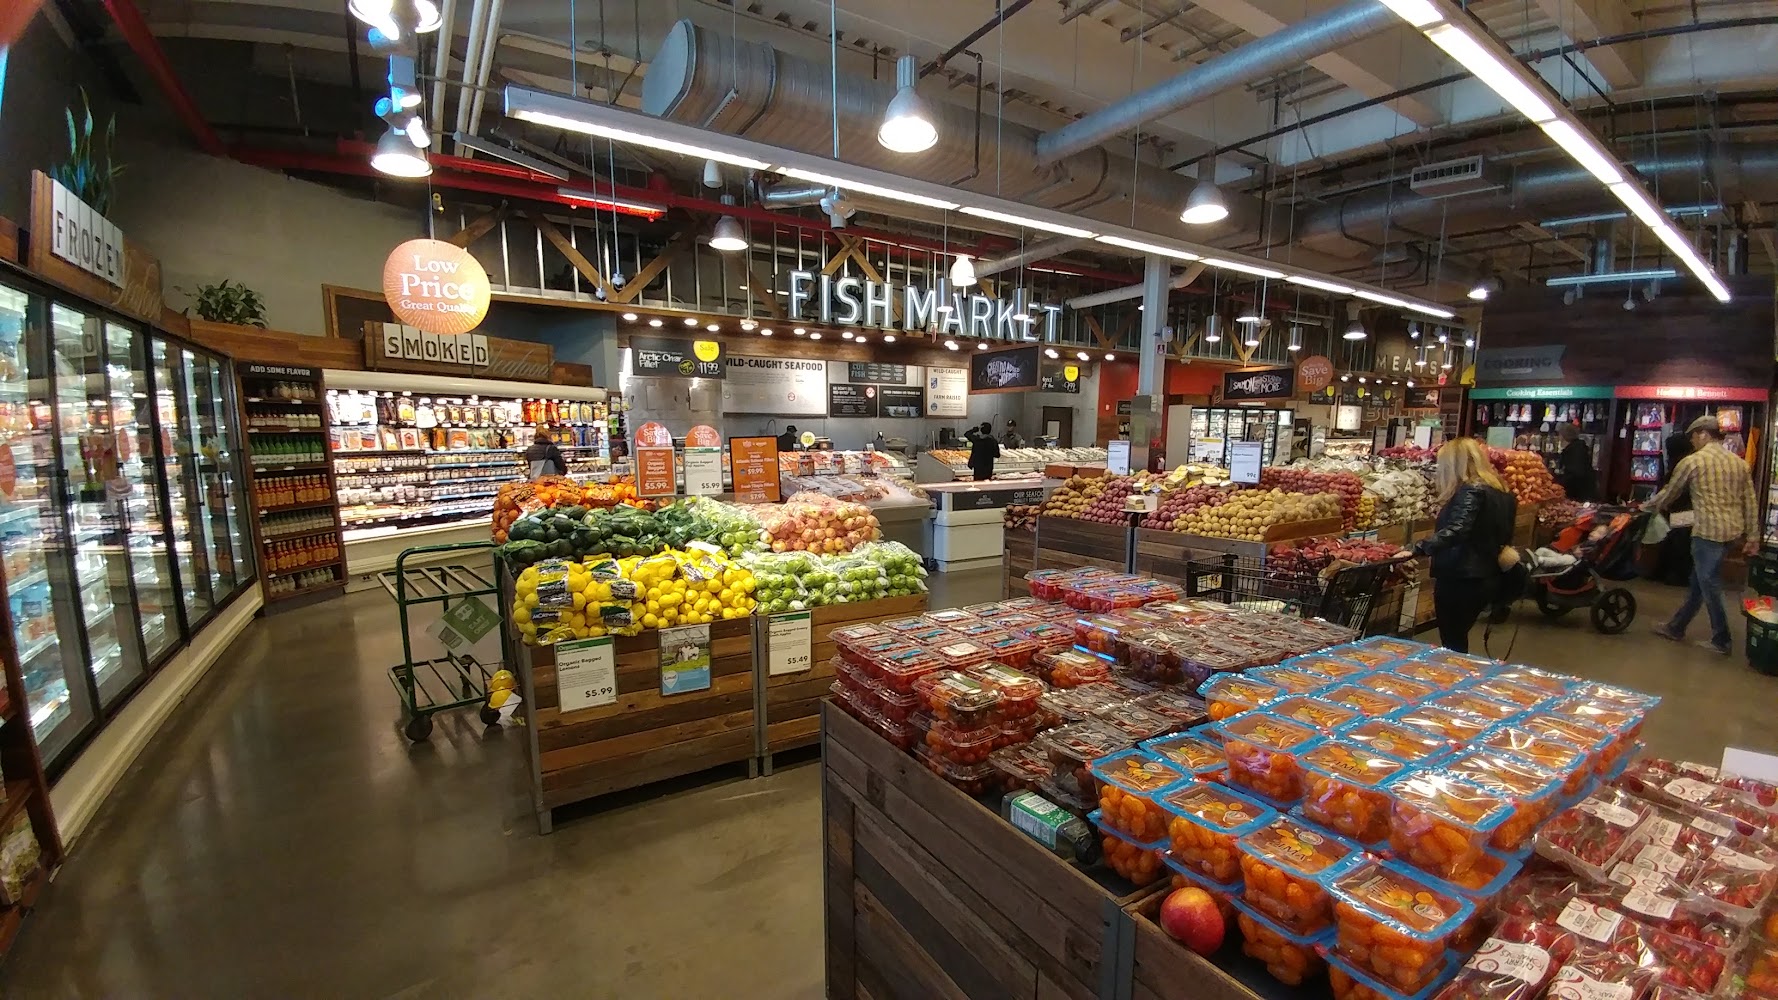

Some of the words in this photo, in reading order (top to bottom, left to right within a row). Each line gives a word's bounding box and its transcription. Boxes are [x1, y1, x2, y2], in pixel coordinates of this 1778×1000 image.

[412, 255, 460, 274] Low
[400, 273, 475, 301] Price
[400, 299, 434, 312] Great
[788, 268, 893, 328] FISH
[903, 285, 1063, 342] MARKET
[387, 336, 487, 363] SMOKED
[638, 352, 661, 362] Arctic
[662, 353, 684, 363] Char
[1484, 357, 1552, 369] COOKING
[639, 360, 659, 369] Fillet
[785, 361, 823, 371] SEAFOOD
[1302, 365, 1328, 376] Save
[1375, 355, 1437, 375] MEATS
[250, 365, 265, 373] ADD
[266, 366, 285, 374] SOME
[286, 368, 311, 377] FLAVOR
[1233, 376, 1256, 393] SALMON
[1304, 375, 1323, 387] Big
[1261, 382, 1281, 393] MORE
[1506, 389, 1536, 398] Cooking
[1537, 388, 1573, 397] Essentials
[1697, 389, 1727, 398] Bennett
[694, 431, 713, 439] Save
[644, 482, 667, 490] $5.99
[559, 659, 580, 668] Organic
[581, 656, 602, 664] Bagged
[787, 655, 808, 665] $5.49
[585, 686, 613, 698] $5.99
